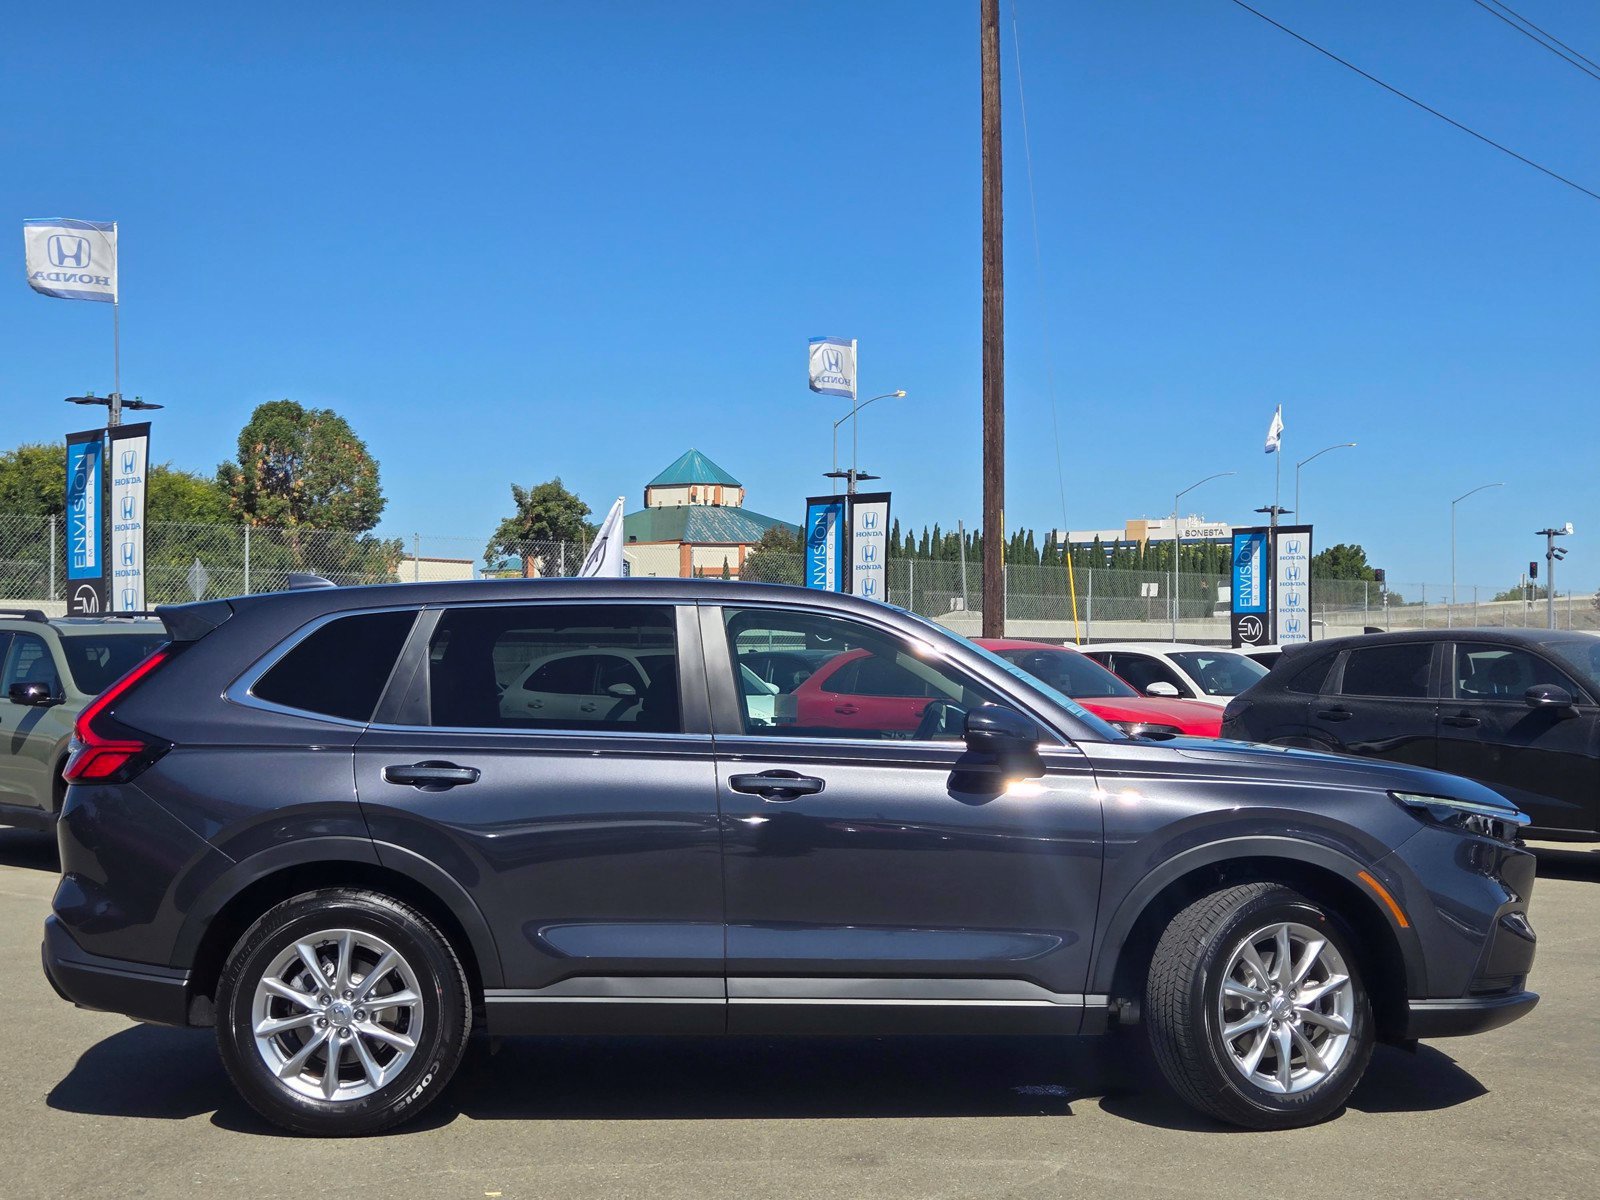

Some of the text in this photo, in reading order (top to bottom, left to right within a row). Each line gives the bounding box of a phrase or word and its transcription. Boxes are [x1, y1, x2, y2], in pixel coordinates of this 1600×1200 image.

[114, 476, 142, 487] HONDA
[74, 454, 86, 568] ENVISION
[114, 522, 142, 532] HONDA
[1184, 528, 1224, 537] SONESTA
[114, 568, 141, 578] HONDA
[1240, 540, 1251, 607] ENVISION
